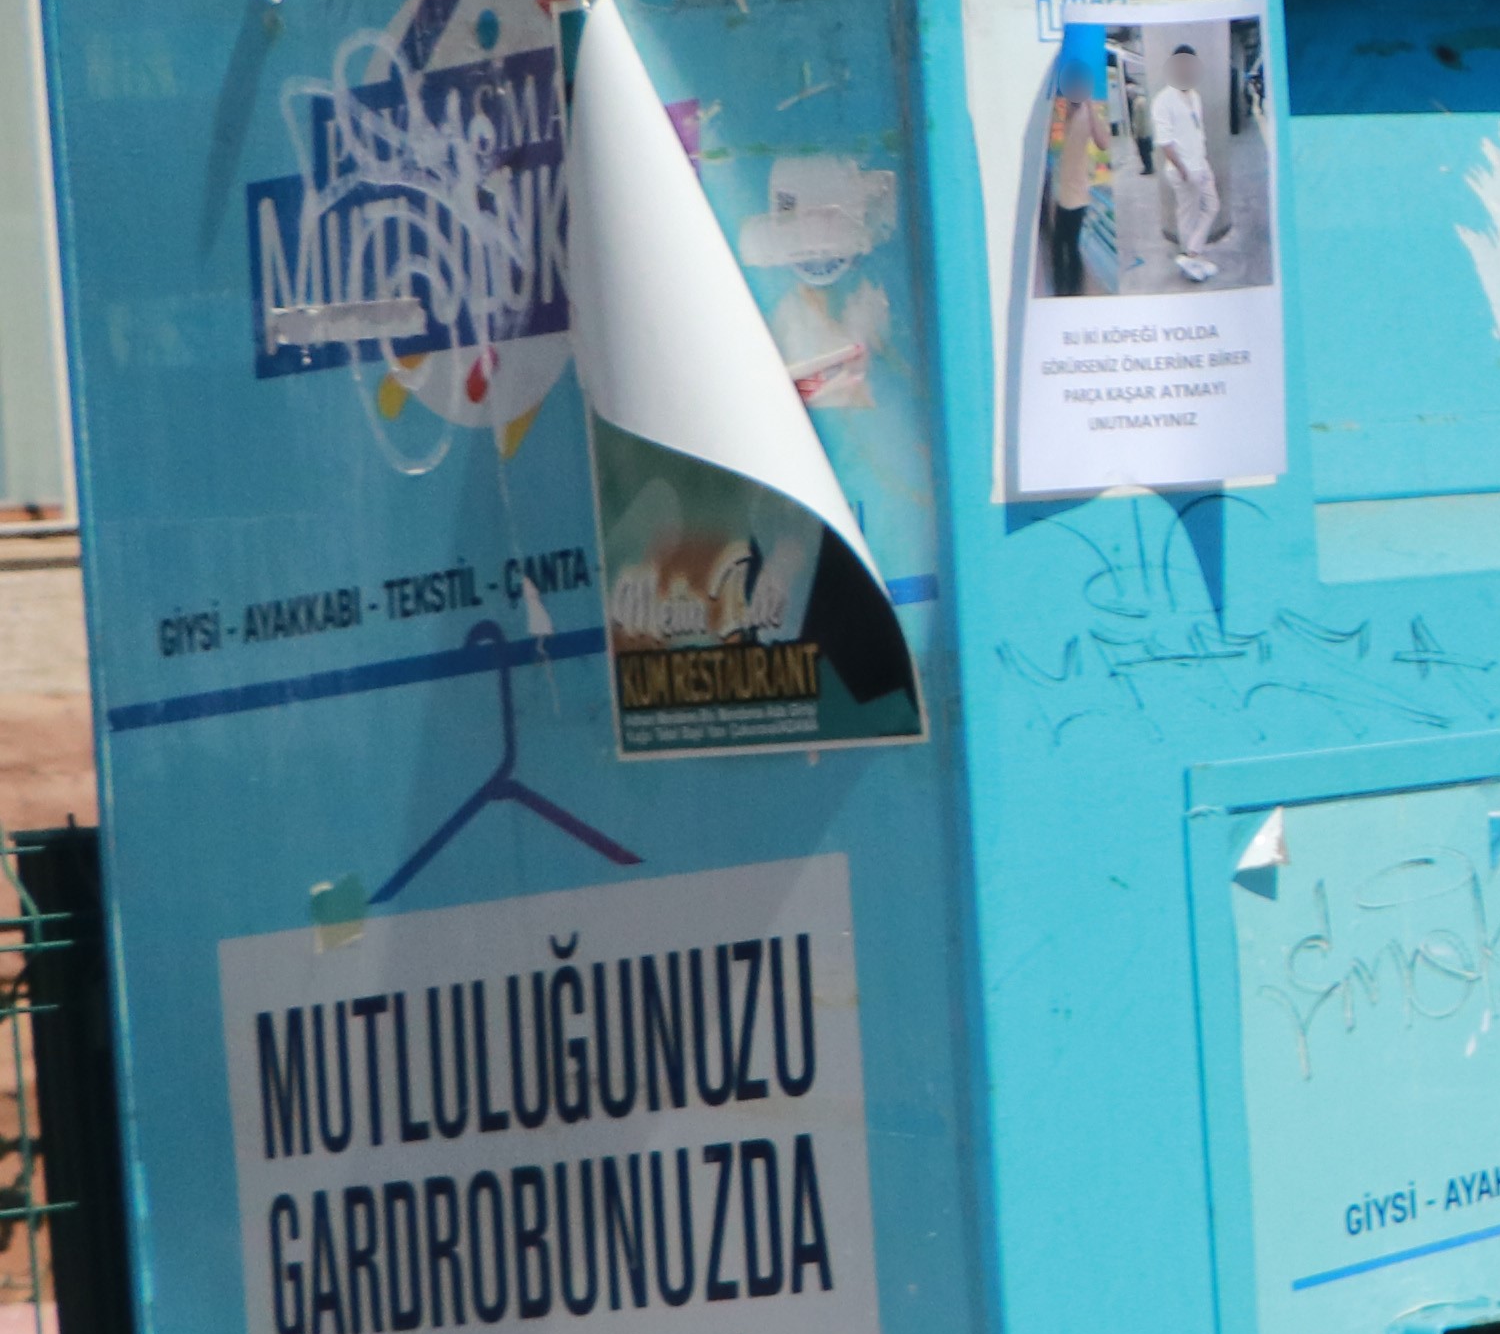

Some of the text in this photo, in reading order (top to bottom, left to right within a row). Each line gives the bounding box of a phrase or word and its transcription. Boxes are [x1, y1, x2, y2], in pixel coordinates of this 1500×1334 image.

[1101, 323, 1158, 345] KÖPEĞİ
[1161, 324, 1220, 342] YOLDA
[1041, 348, 1252, 376] GÖRÜRSENİZ ÖNLERİNE BİRER
[1063, 380, 1228, 405] PARÇA KAŞAR ATMAYI
[1088, 411, 1198, 431] UNUTMAYINIZ
[157, 599, 222, 659] GİYSİ
[243, 585, 361, 644] AYAKKABI
[382, 555, 484, 621] TEKSTİL
[503, 547, 591, 610] ÇANTA
[671, 641, 820, 705] RESTAURANT
[256, 931, 816, 1159] MUTLULUĞUNUZU
[1344, 1180, 1418, 1238] GİYSİ
